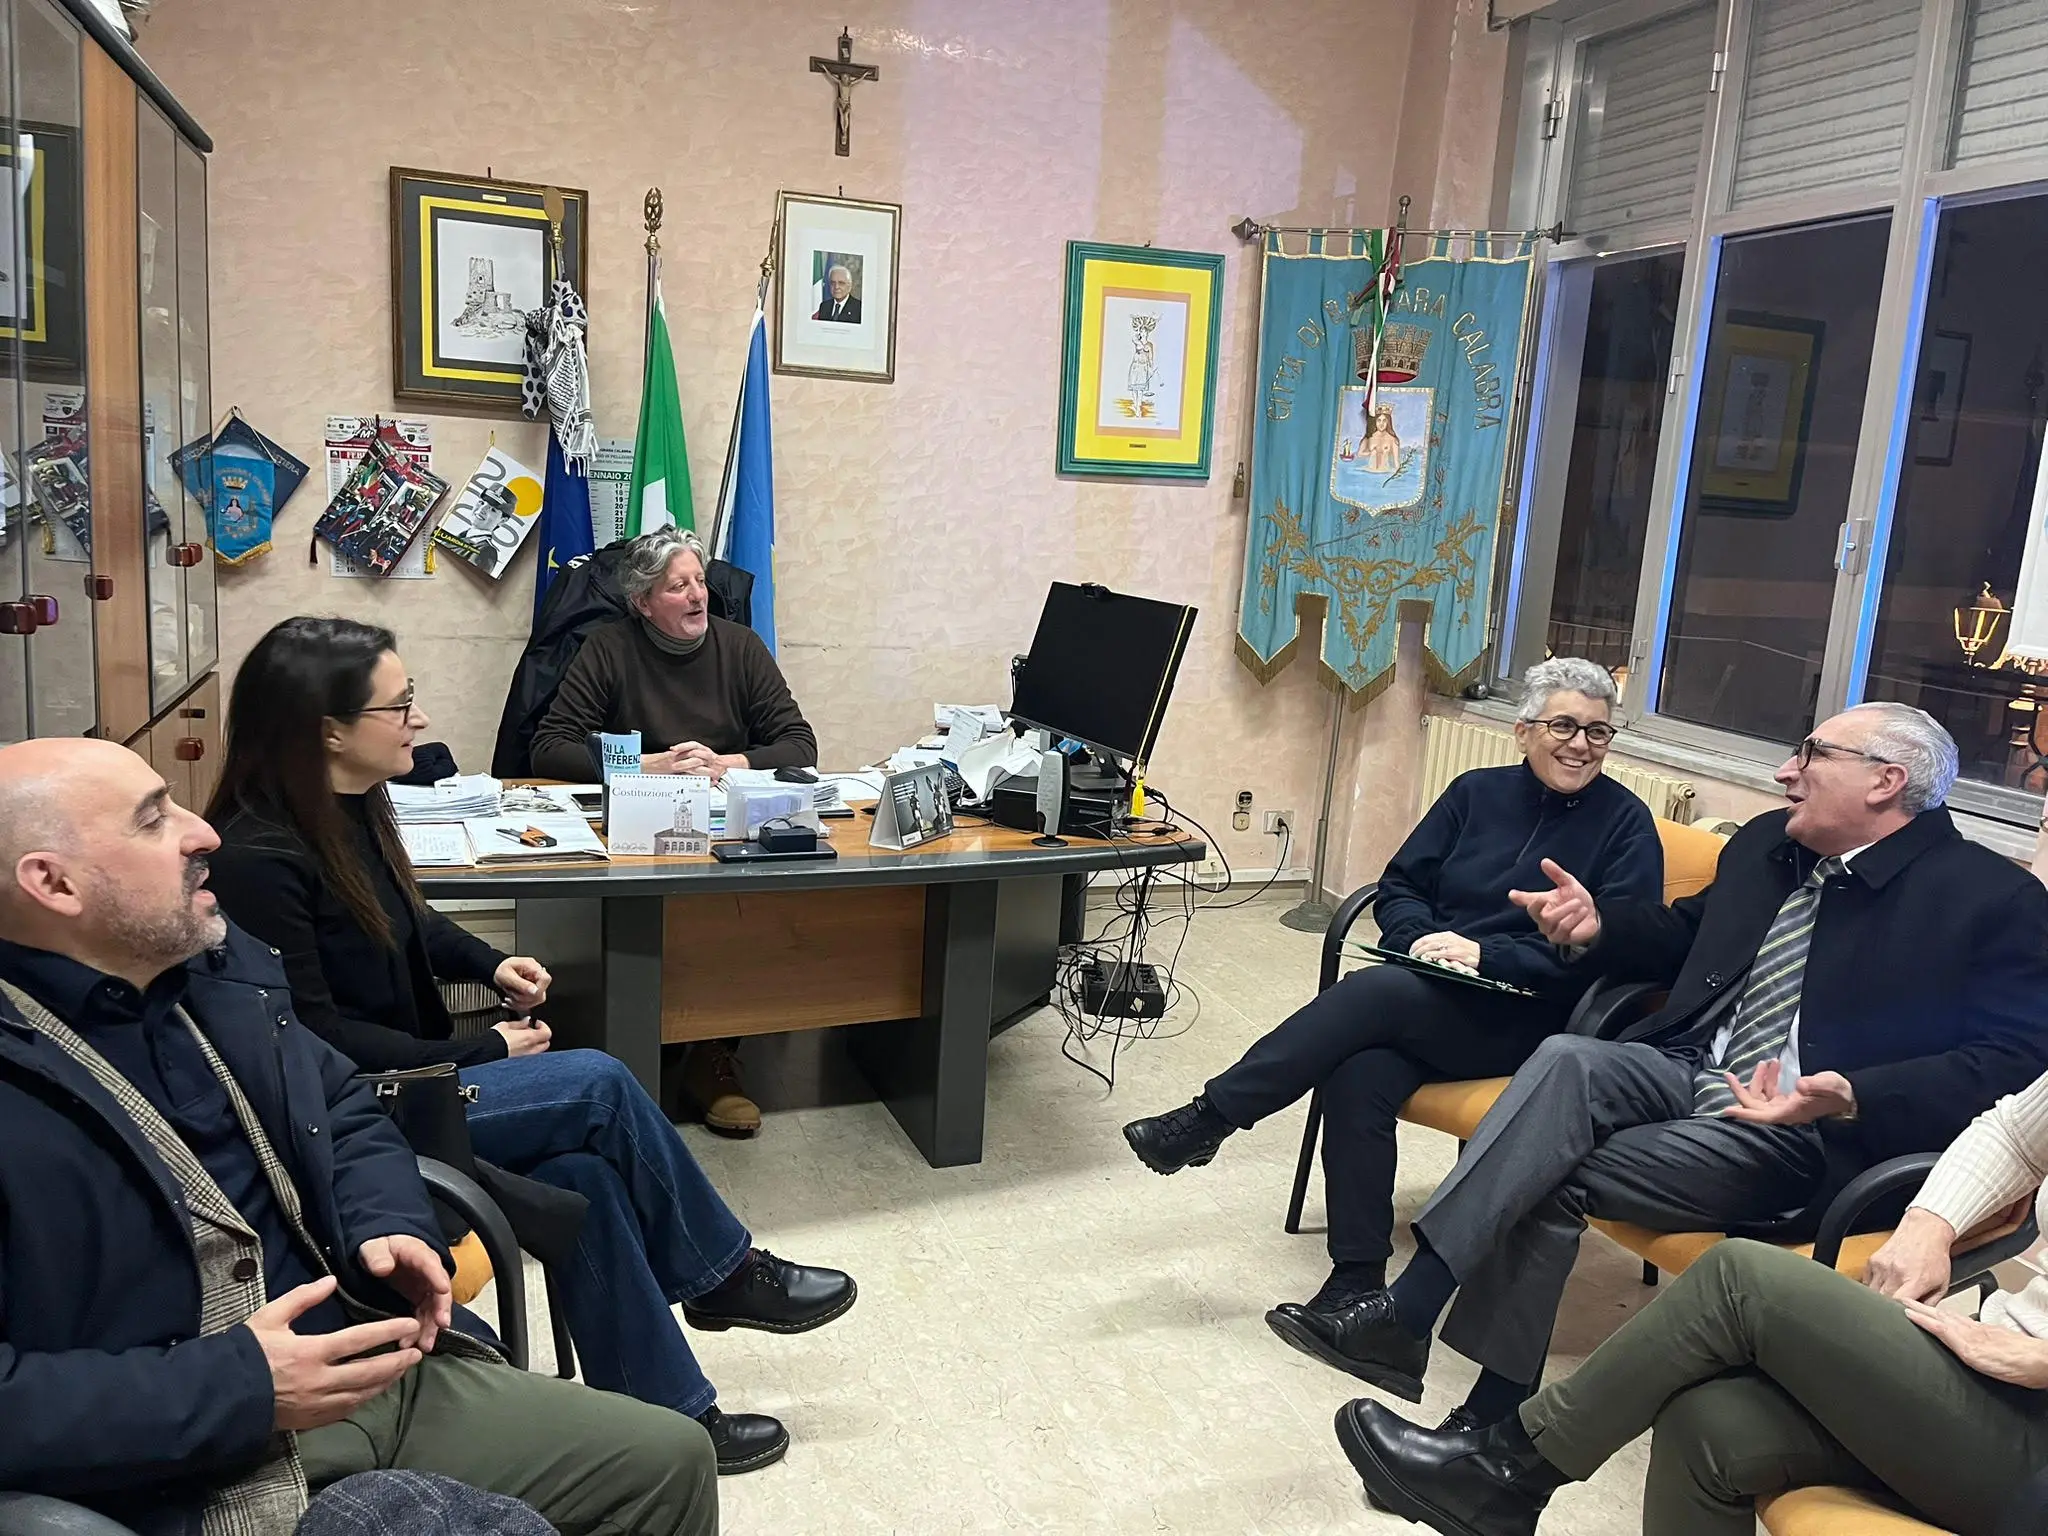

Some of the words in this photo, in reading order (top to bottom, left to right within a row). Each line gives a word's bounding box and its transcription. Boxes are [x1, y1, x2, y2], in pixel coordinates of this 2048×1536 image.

[1296, 318, 1326, 349] DI
[1324, 287, 1447, 325] BARA
[1452, 312, 1502, 430] CALABRA
[589, 471, 622, 480] ENNAIO
[614, 744, 625, 754] LA
[604, 753, 641, 765] DIFFERENZ
[612, 787, 673, 798] Costituzione
